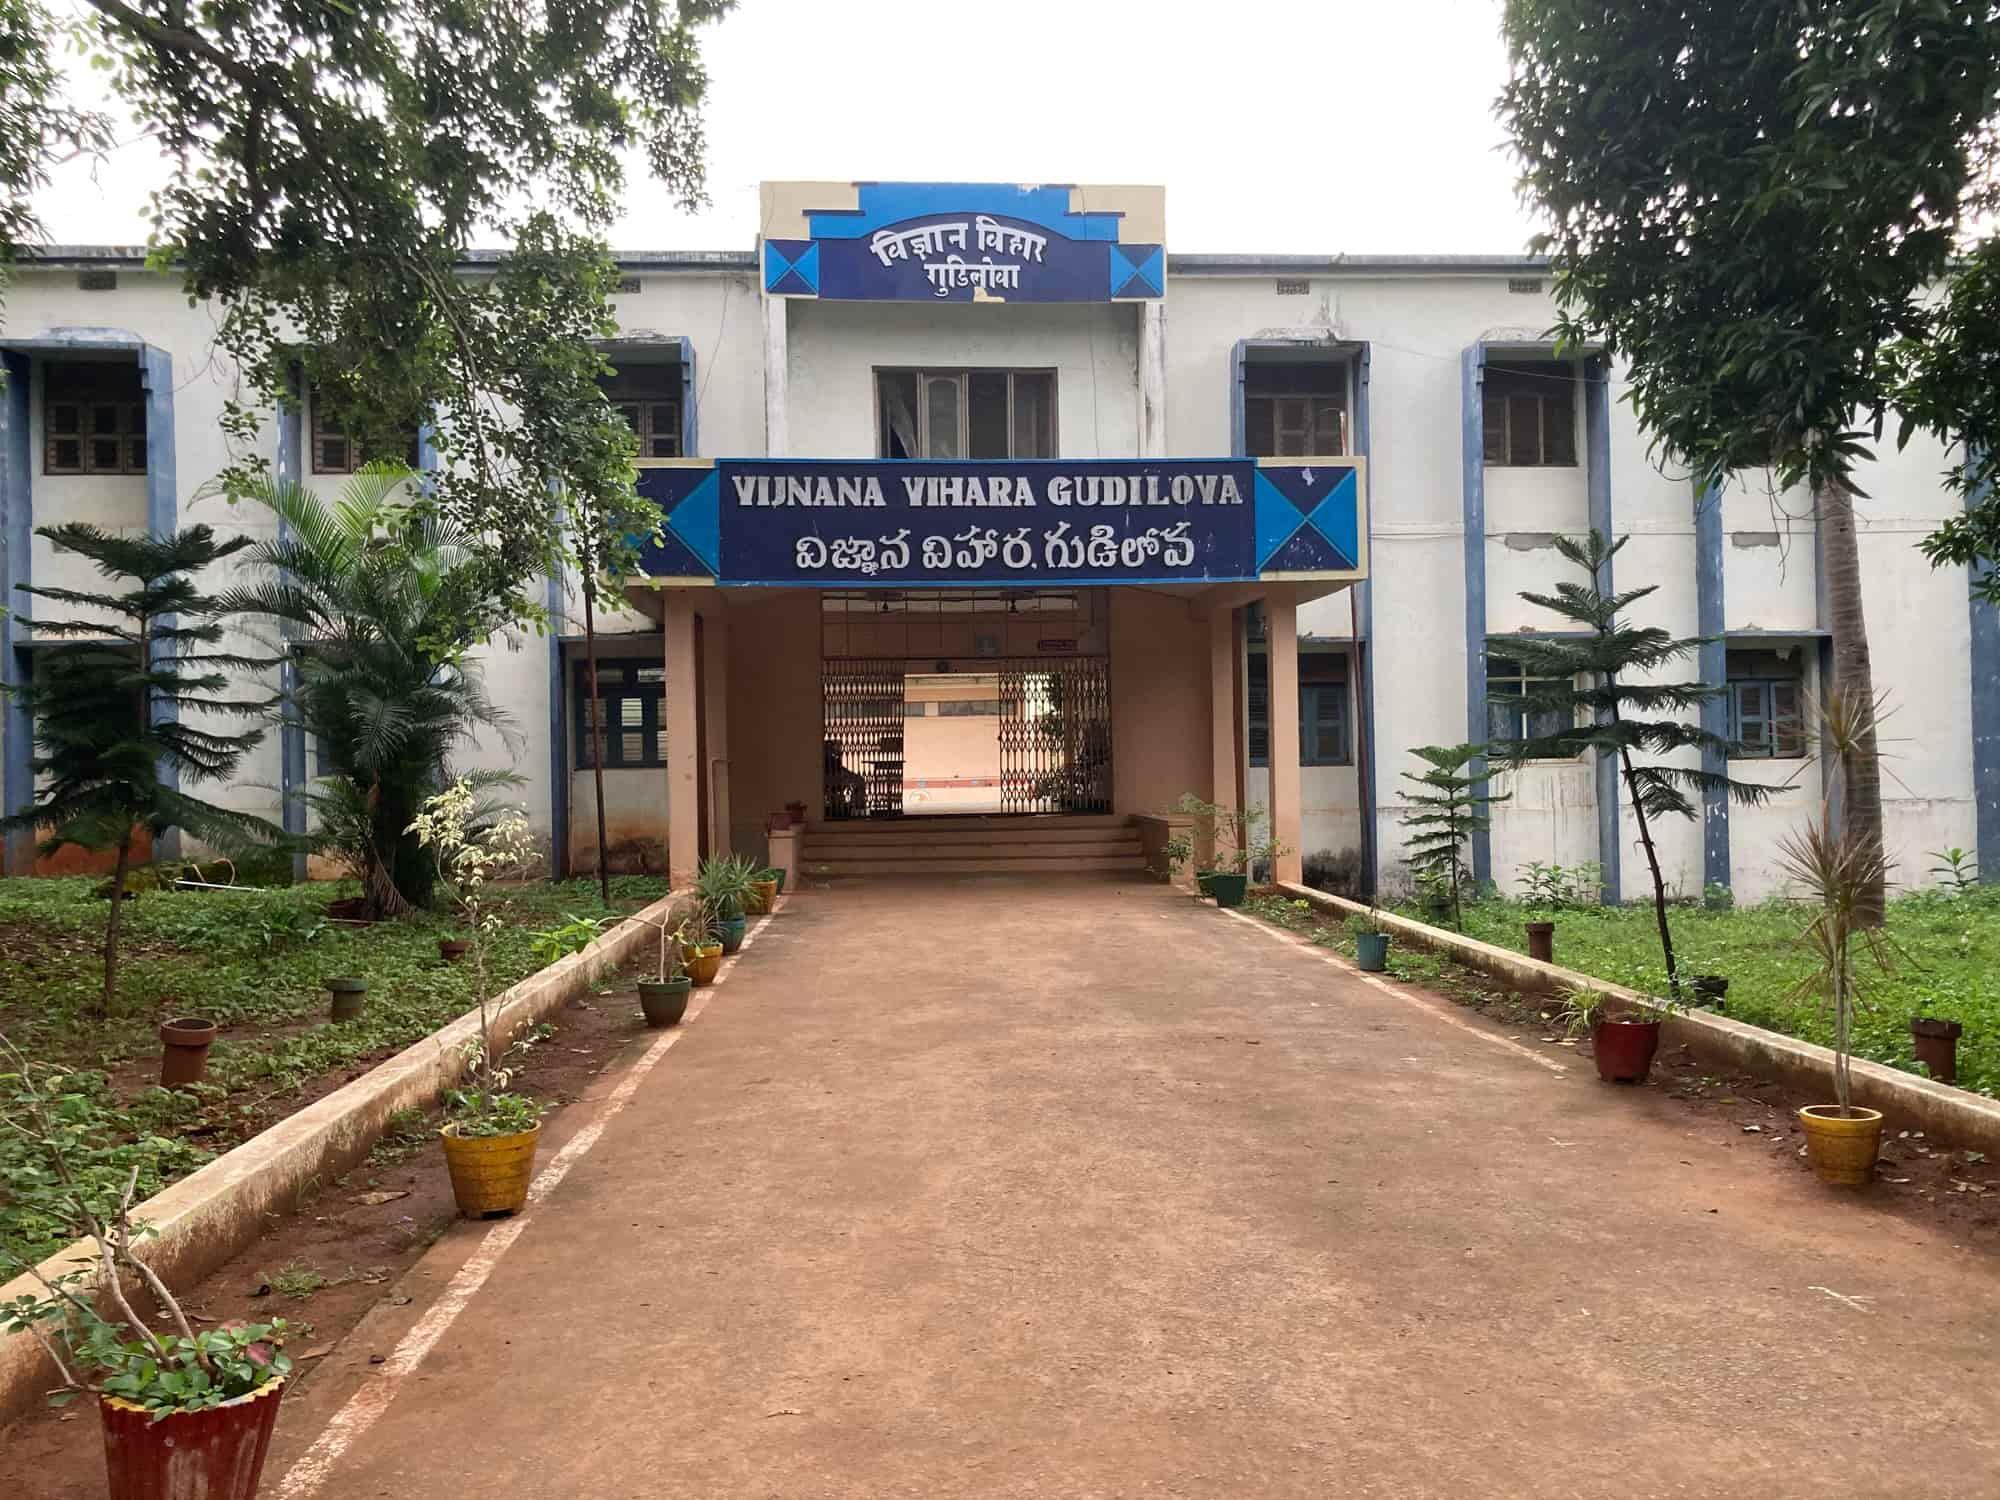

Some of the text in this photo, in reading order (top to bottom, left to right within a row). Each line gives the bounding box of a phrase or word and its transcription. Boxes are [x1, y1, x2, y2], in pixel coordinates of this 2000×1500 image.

[870, 215, 1047, 266] विज्ञान विहार
[924, 254, 1020, 296] गुडिलोवा
[732, 475, 1243, 507] VIJNANA VIHARA GUDILOVA
[795, 528, 911, 576] విజ్ఞాన
[1043, 521, 1195, 568] గుడిలోవ
